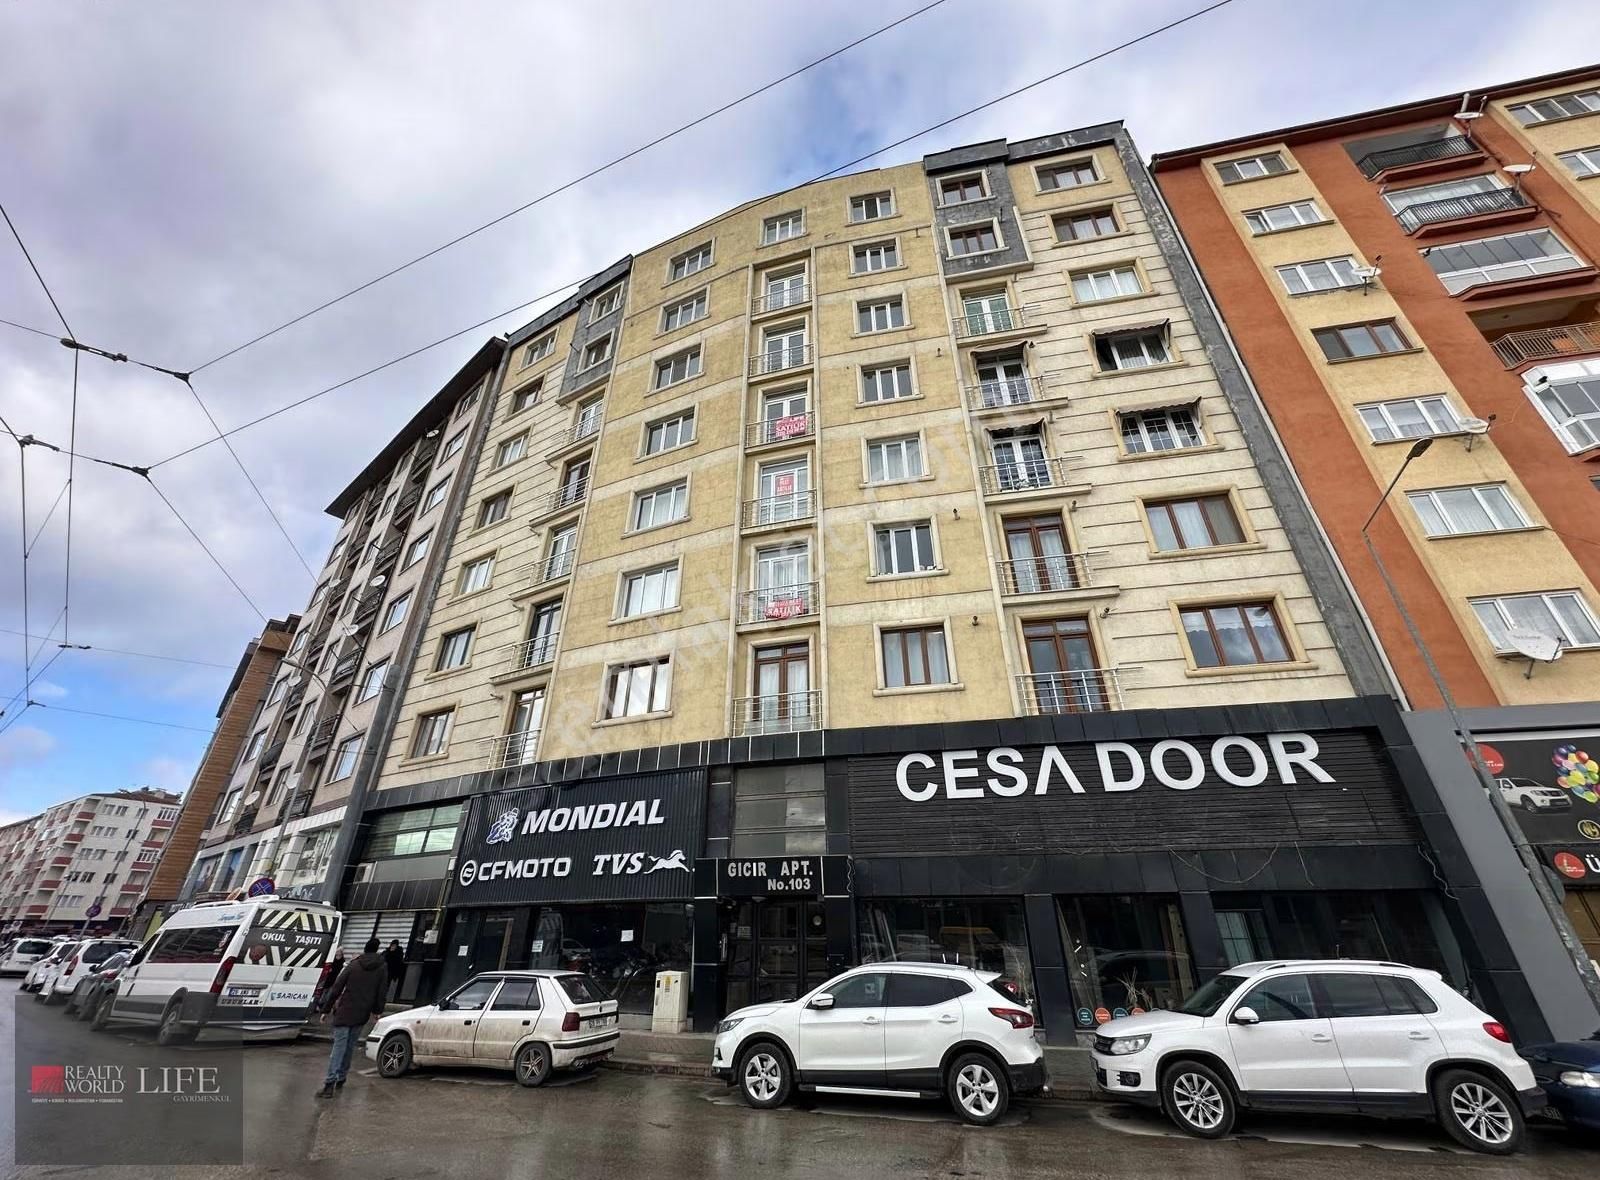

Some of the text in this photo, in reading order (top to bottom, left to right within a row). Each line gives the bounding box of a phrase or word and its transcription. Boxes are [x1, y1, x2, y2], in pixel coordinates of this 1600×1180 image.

[895, 732, 1337, 801] CESA DOOR
[521, 798, 665, 836] MONDIAL
[477, 852, 648, 881] CFMOTO TVS
[727, 859, 813, 877] GICIR APT.
[767, 878, 812, 891] No.103
[261, 932, 322, 945] OKUL TAŞITI
